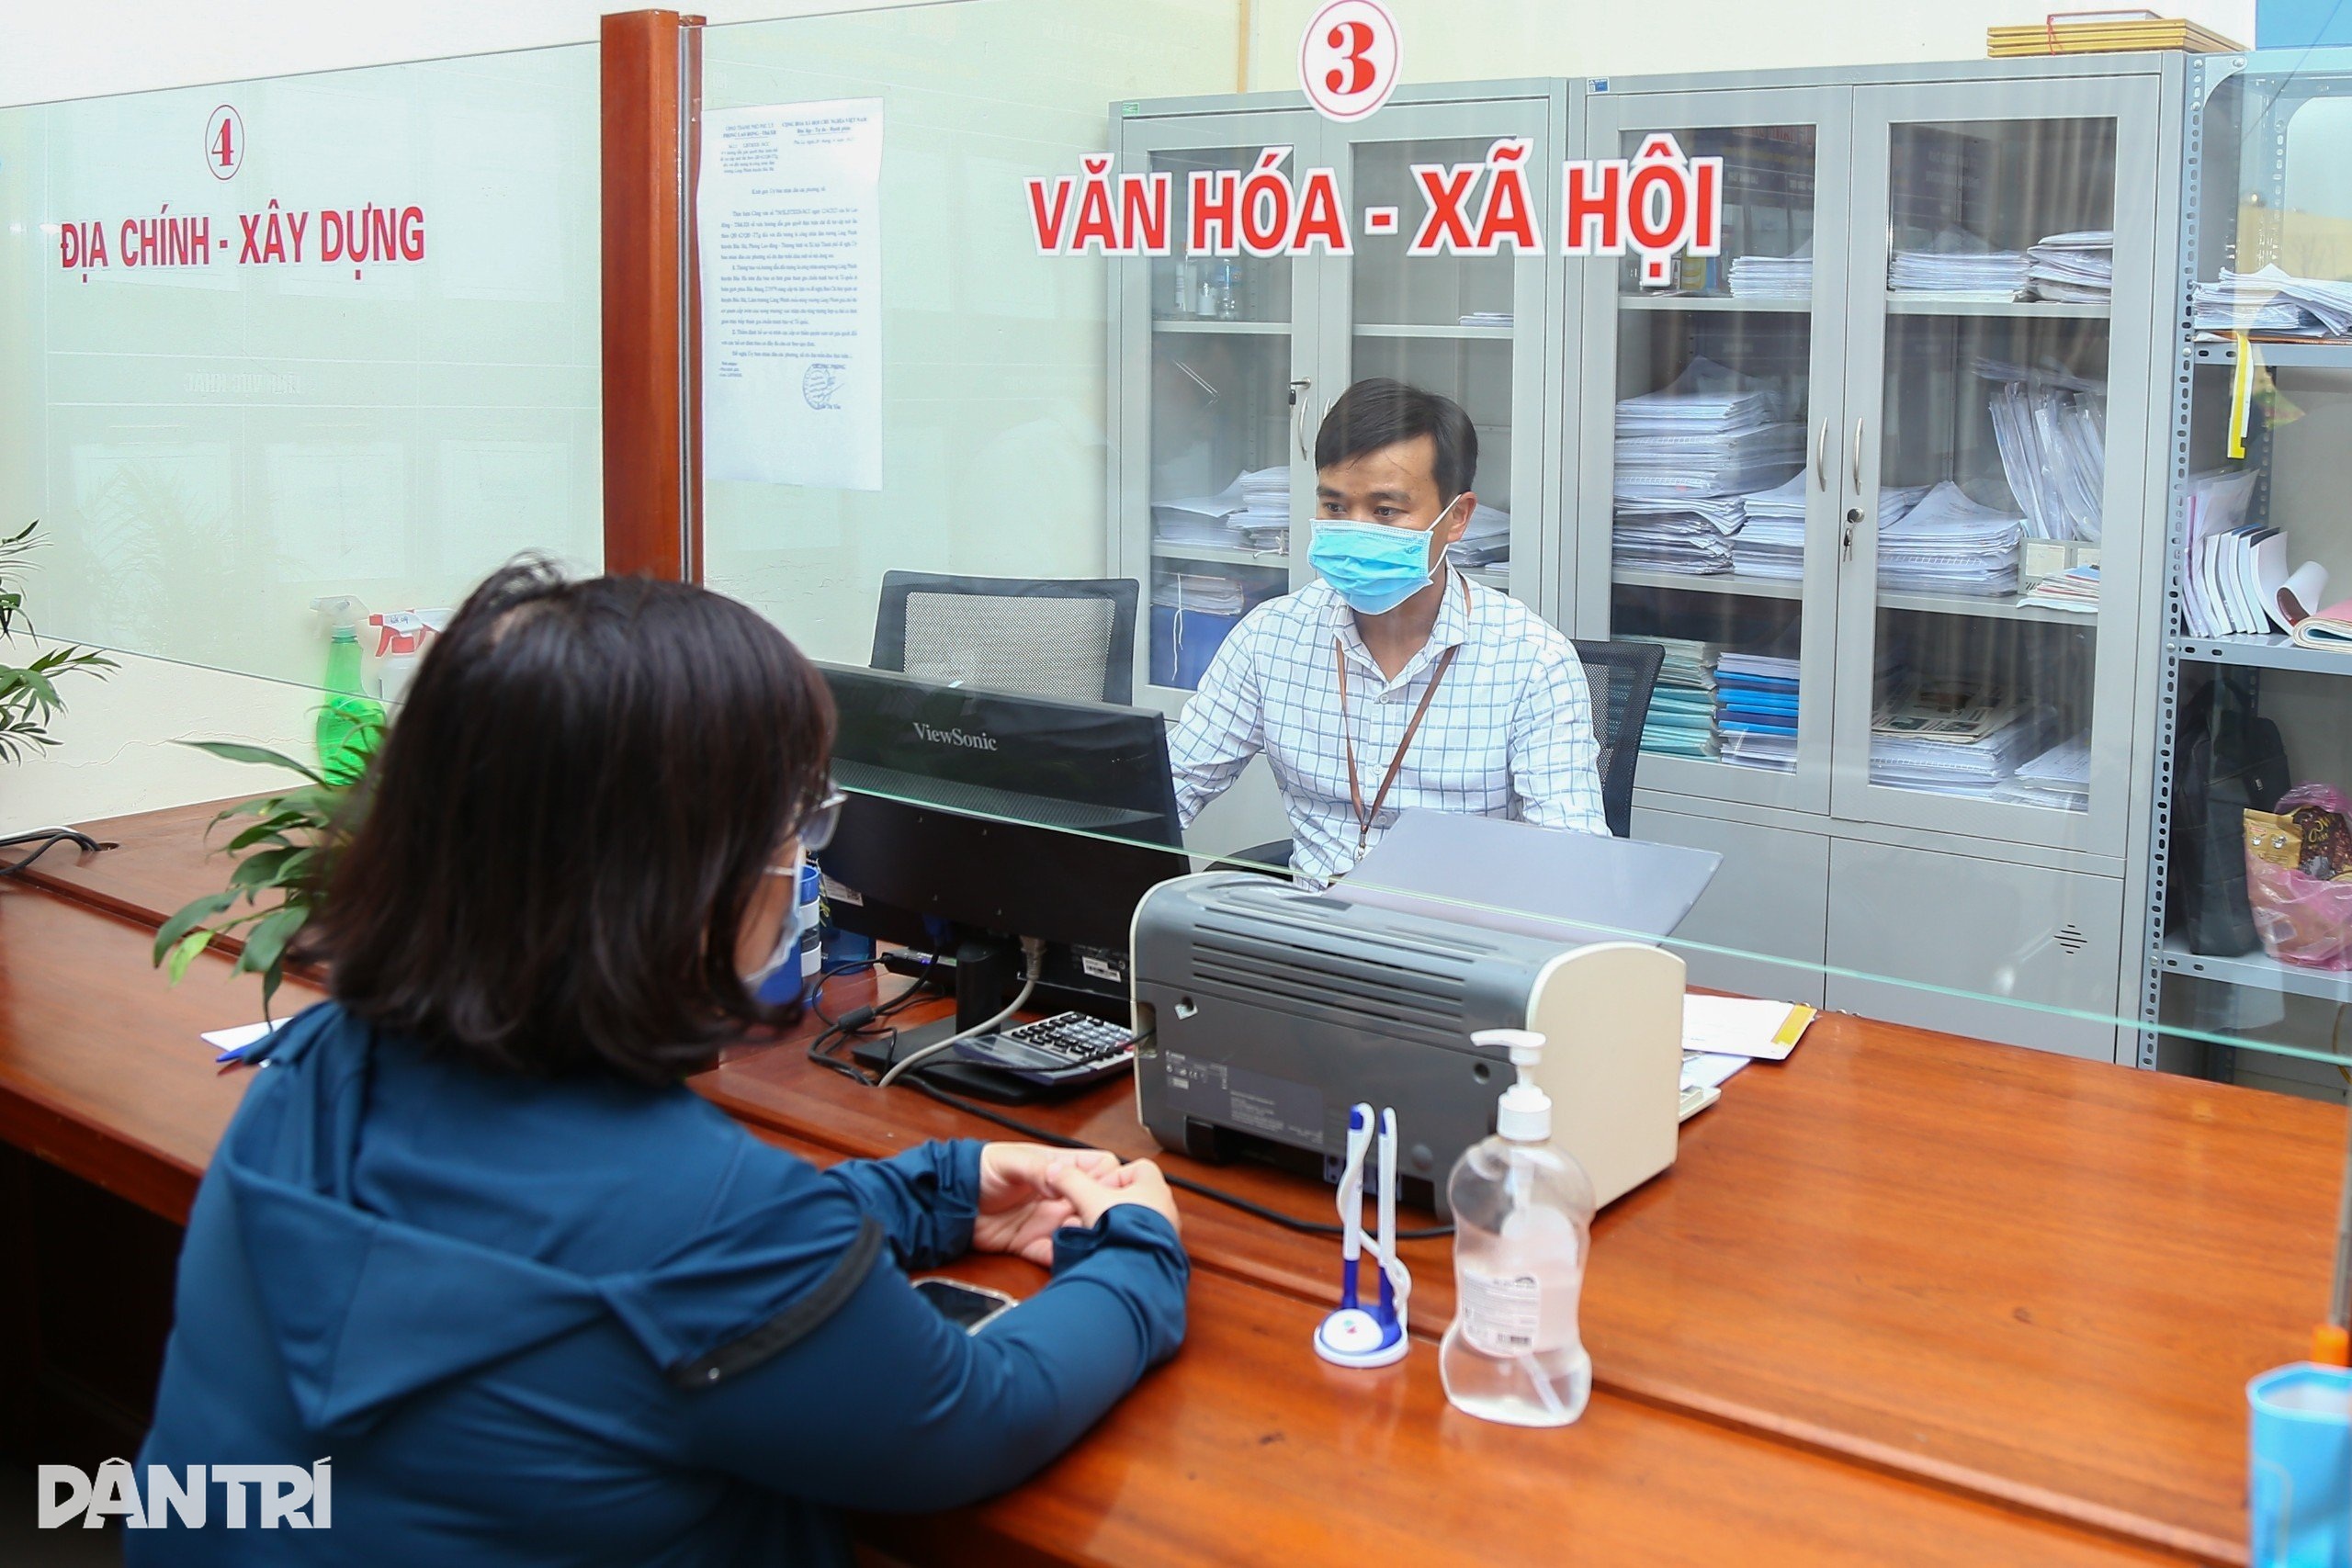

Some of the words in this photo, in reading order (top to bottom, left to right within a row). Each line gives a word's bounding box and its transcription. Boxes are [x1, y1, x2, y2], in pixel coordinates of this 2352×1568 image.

[1325, 20, 1377, 96] 3
[211, 118, 234, 167] 4
[60, 221, 108, 283] ĐỊA
[120, 203, 210, 267] CHÍNH
[238, 198, 309, 265] XÂY
[320, 201, 425, 281] DỰNG
[1029, 157, 1168, 251] VĂN
[1192, 152, 1347, 252] HÓA
[1370, 212, 1393, 229] -
[1417, 145, 1536, 250] XÃ
[1566, 140, 1715, 280] HỘI
[912, 721, 998, 751] ViewSonic
